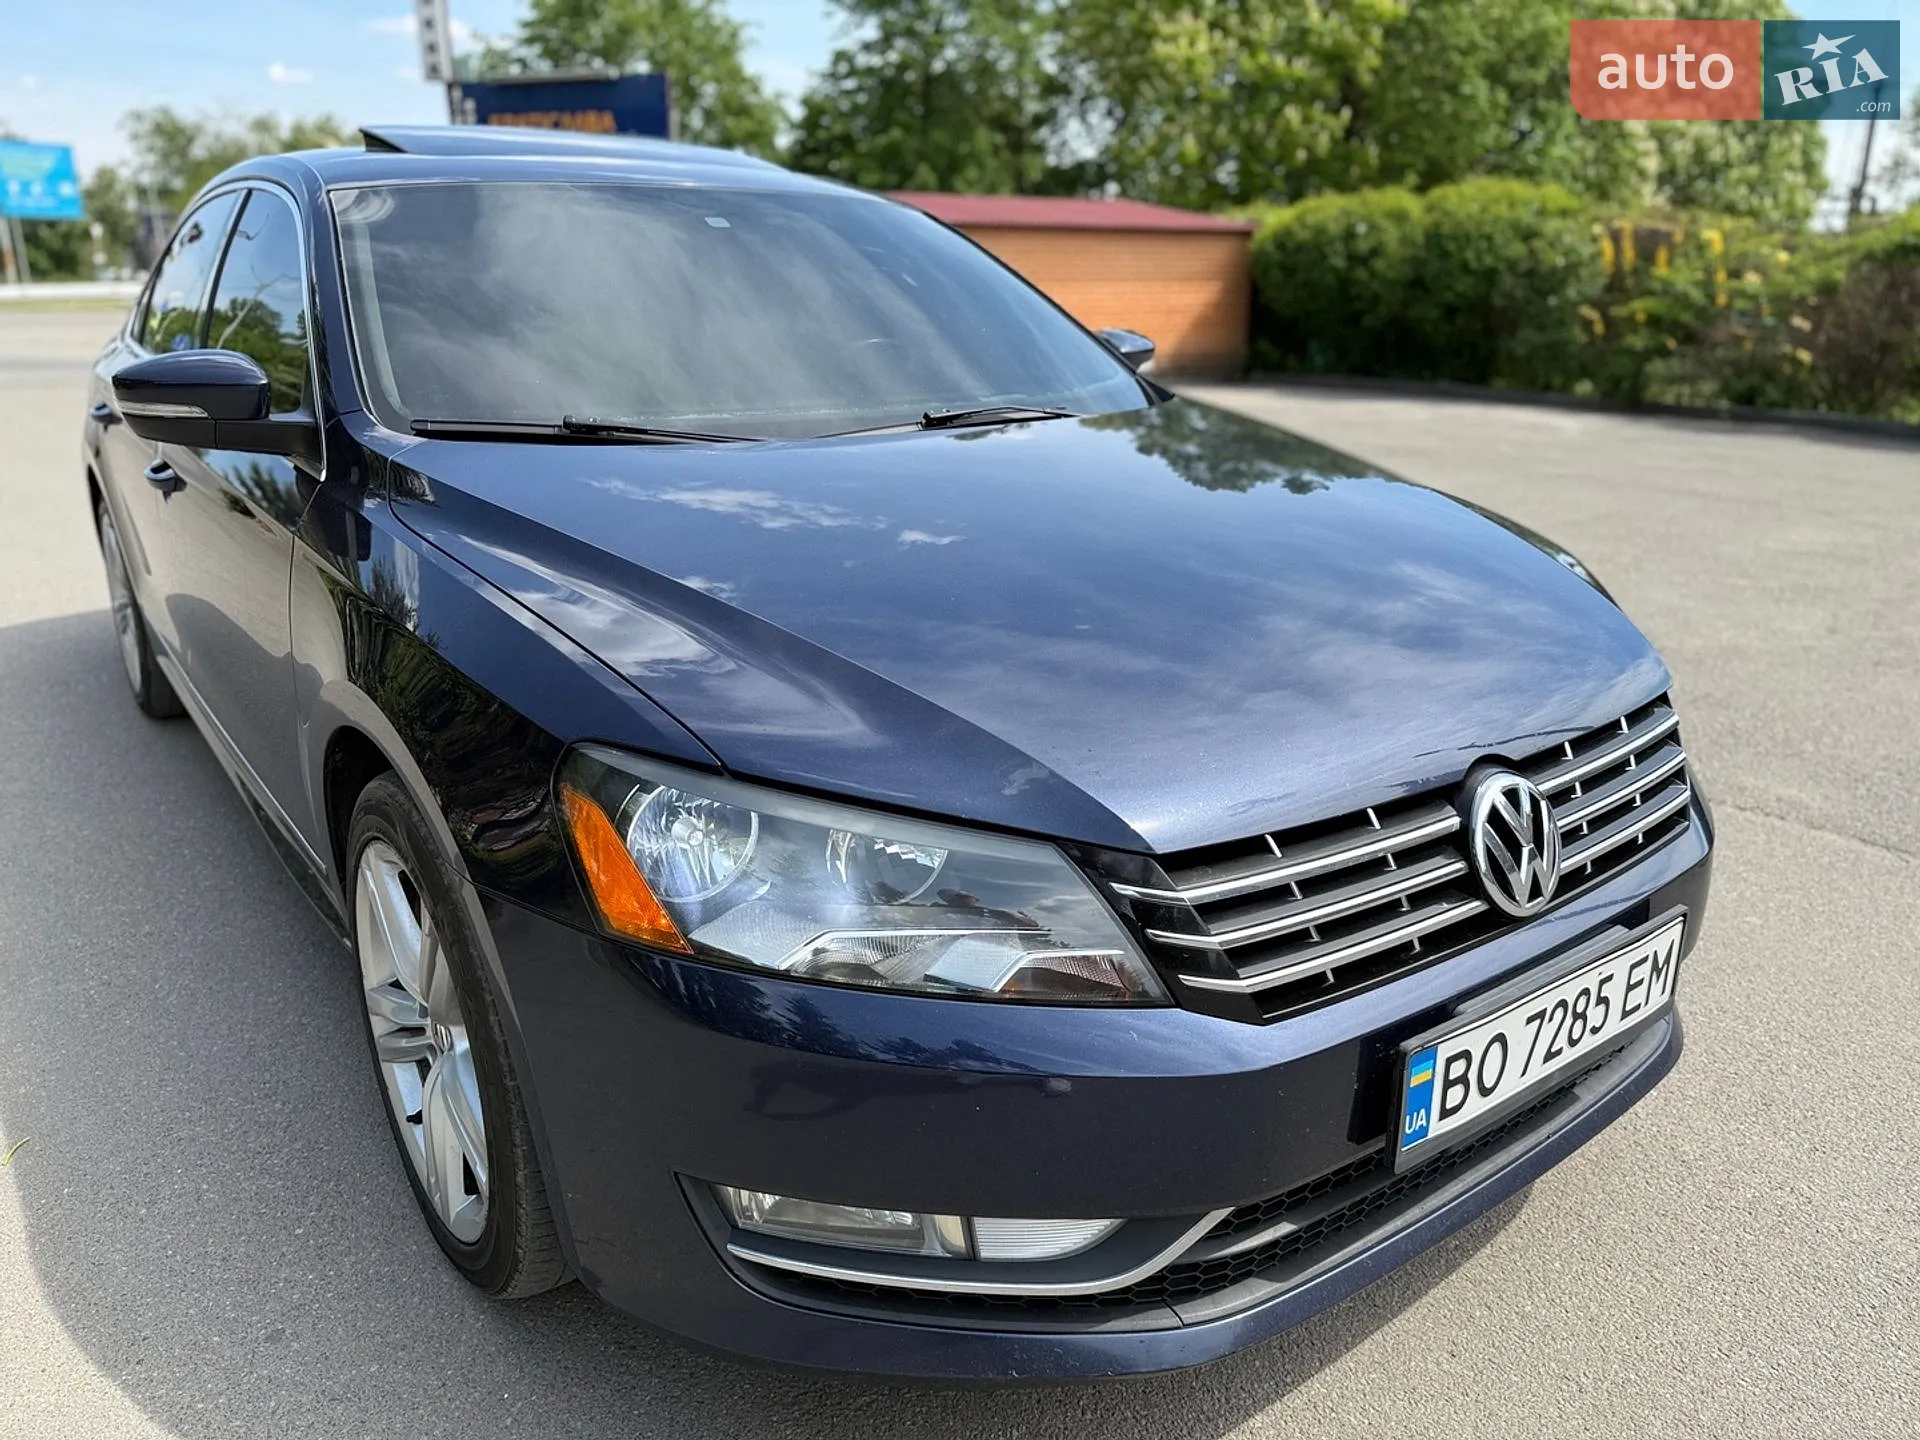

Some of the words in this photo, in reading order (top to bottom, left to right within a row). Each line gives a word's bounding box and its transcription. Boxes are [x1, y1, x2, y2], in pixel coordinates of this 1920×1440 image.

[1438, 1032, 1509, 1122] BO
[1520, 972, 1614, 1078] 7285
[1620, 939, 1676, 1022] EM
[1404, 1110, 1427, 1135] UA
